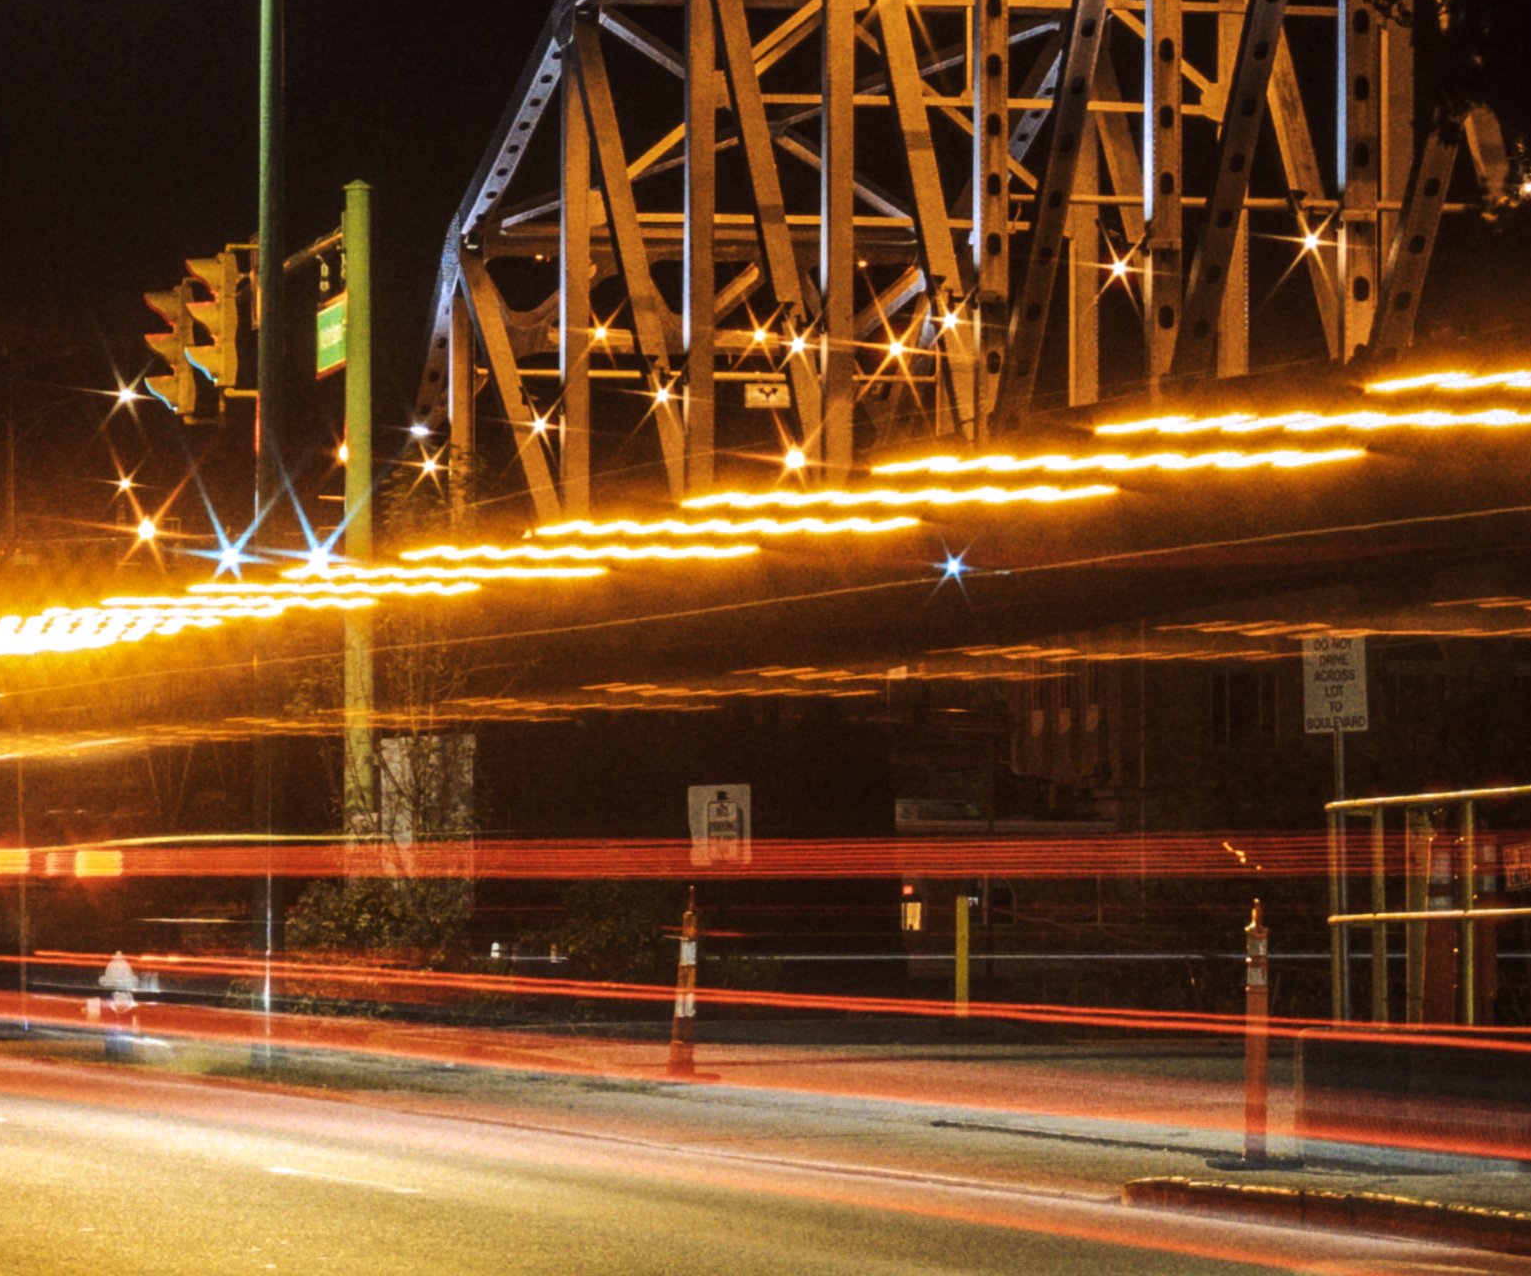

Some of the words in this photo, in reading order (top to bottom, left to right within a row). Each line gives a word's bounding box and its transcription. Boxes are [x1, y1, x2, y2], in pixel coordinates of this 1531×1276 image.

[1313, 638, 1329, 651] DO
[1319, 654, 1349, 666] DRIVE
[1314, 669, 1356, 682] ACROSS
[1325, 685, 1344, 697] LOT
[1329, 701, 1343, 713] TO
[1306, 715, 1366, 730] BOULEVARD
